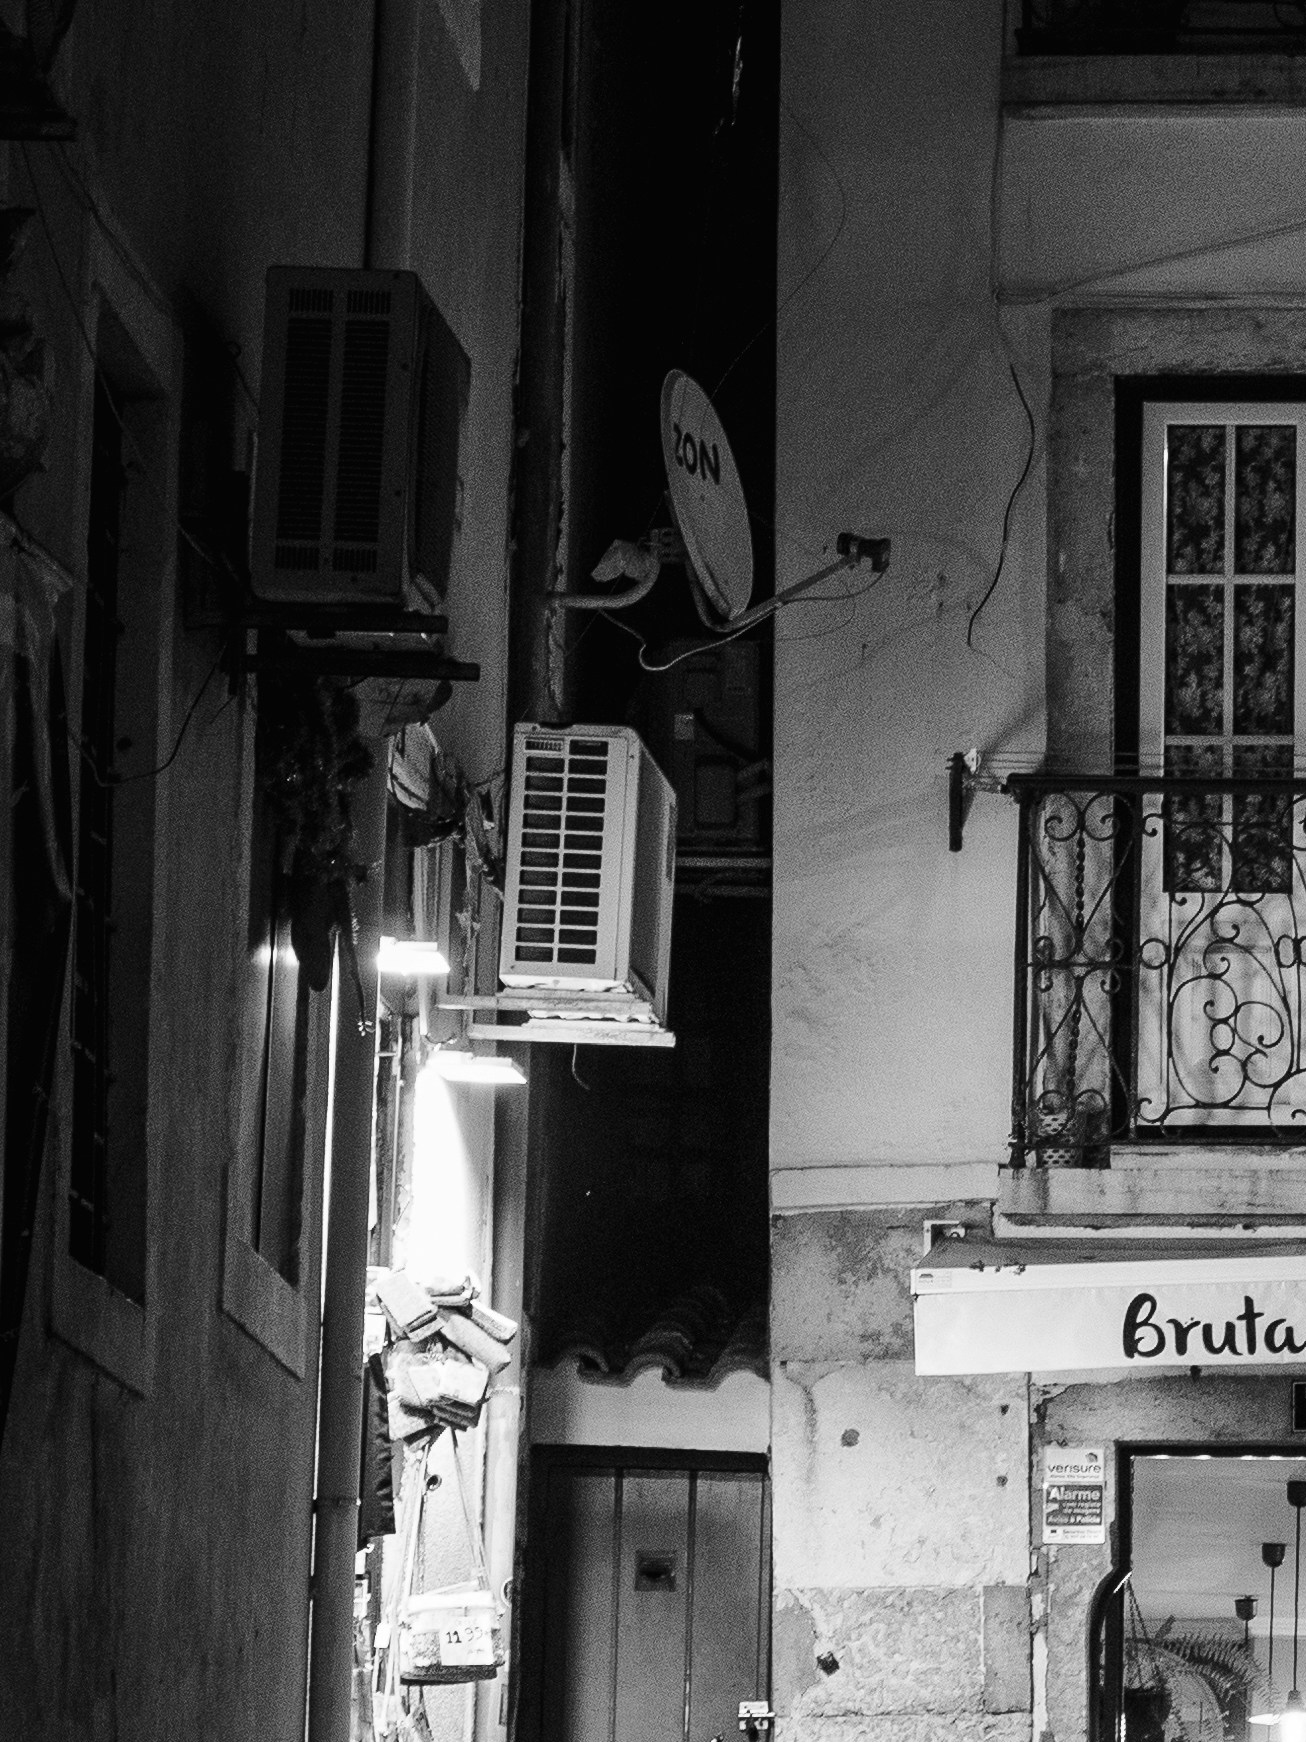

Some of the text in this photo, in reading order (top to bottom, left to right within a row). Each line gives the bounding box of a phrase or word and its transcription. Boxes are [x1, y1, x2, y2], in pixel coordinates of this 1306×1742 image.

[673, 422, 720, 485] ZON
[1047, 1464, 1102, 1474] verisure
[1048, 1485, 1101, 1501] Alarme
